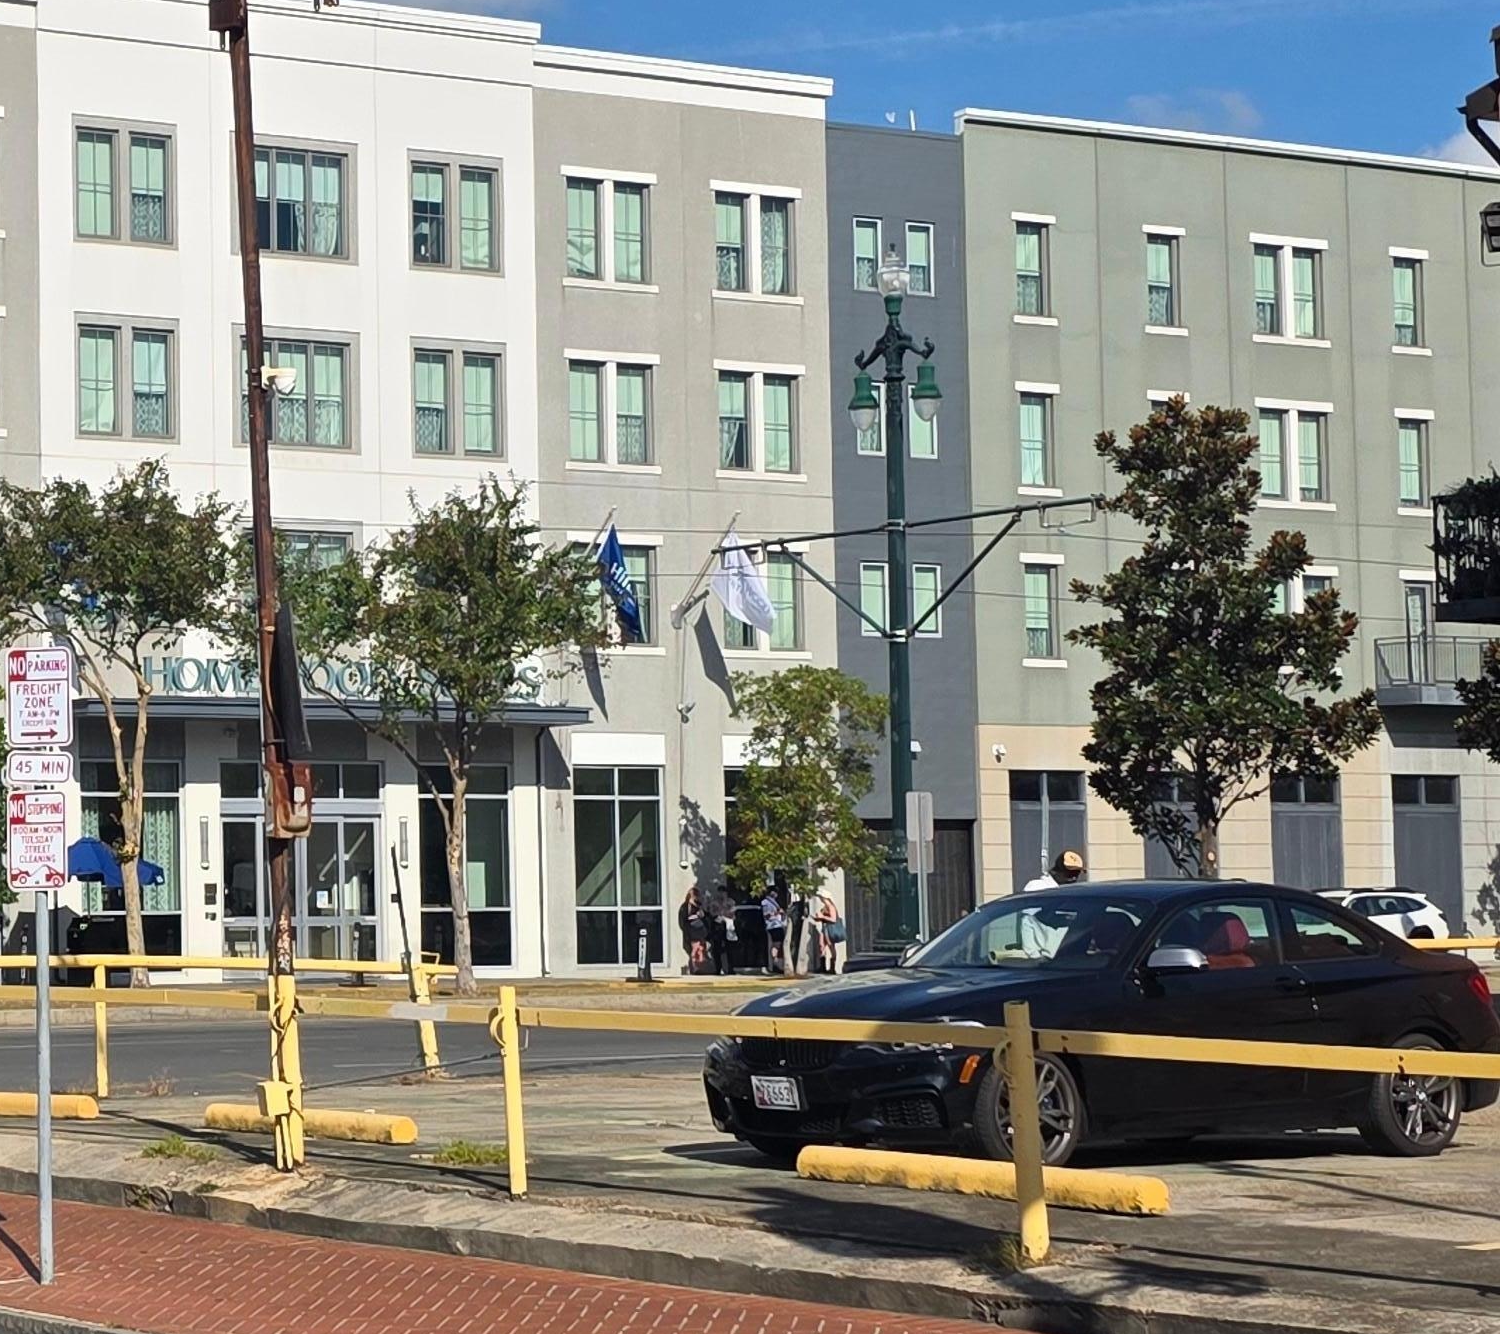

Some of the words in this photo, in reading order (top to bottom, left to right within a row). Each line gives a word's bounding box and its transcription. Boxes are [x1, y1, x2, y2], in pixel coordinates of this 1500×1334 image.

[9, 656, 26, 676] NO
[27, 659, 67, 673] PARKING
[16, 683, 61, 695] FREIGHT
[24, 696, 54, 709] ZONE
[15, 761, 32, 774] 45
[41, 760, 64, 774] MIN
[9, 799, 25, 819] NO
[27, 802, 63, 816] STOPPING
[21, 835, 54, 844] TUESDAY
[24, 844, 51, 854] STREET
[19, 854, 56, 864] CLEANING
